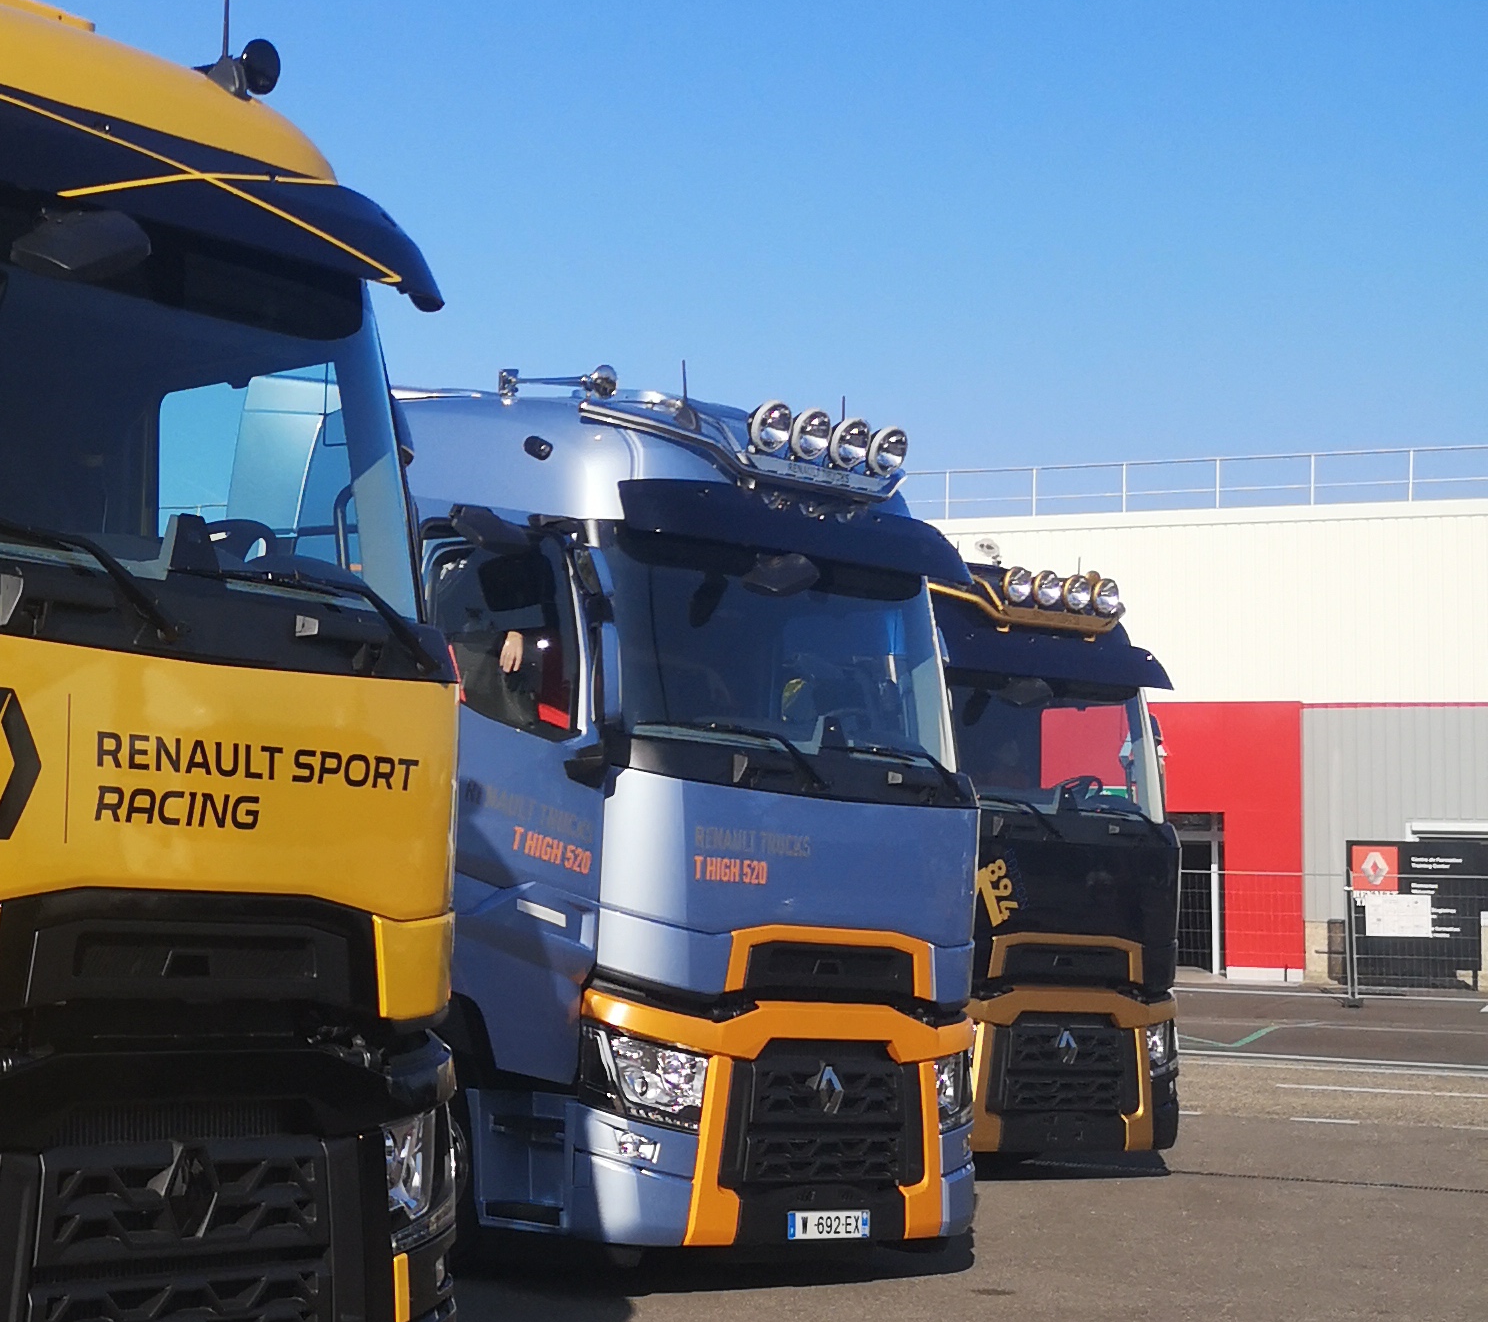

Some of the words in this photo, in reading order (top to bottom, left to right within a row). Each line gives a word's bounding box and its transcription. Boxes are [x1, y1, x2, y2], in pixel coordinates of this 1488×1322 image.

[96, 730, 283, 780] RENAULT
[292, 749, 419, 791] SPORT
[94, 785, 260, 830] RACING
[513, 826, 524, 851] T
[524, 831, 563, 865] HIGH
[564, 844, 592, 875] 520
[695, 826, 756, 852] RENAULT
[760, 831, 811, 857] TRUCKS
[694, 855, 704, 880] T
[706, 857, 740, 882] HIGH
[742, 859, 768, 885] 520
